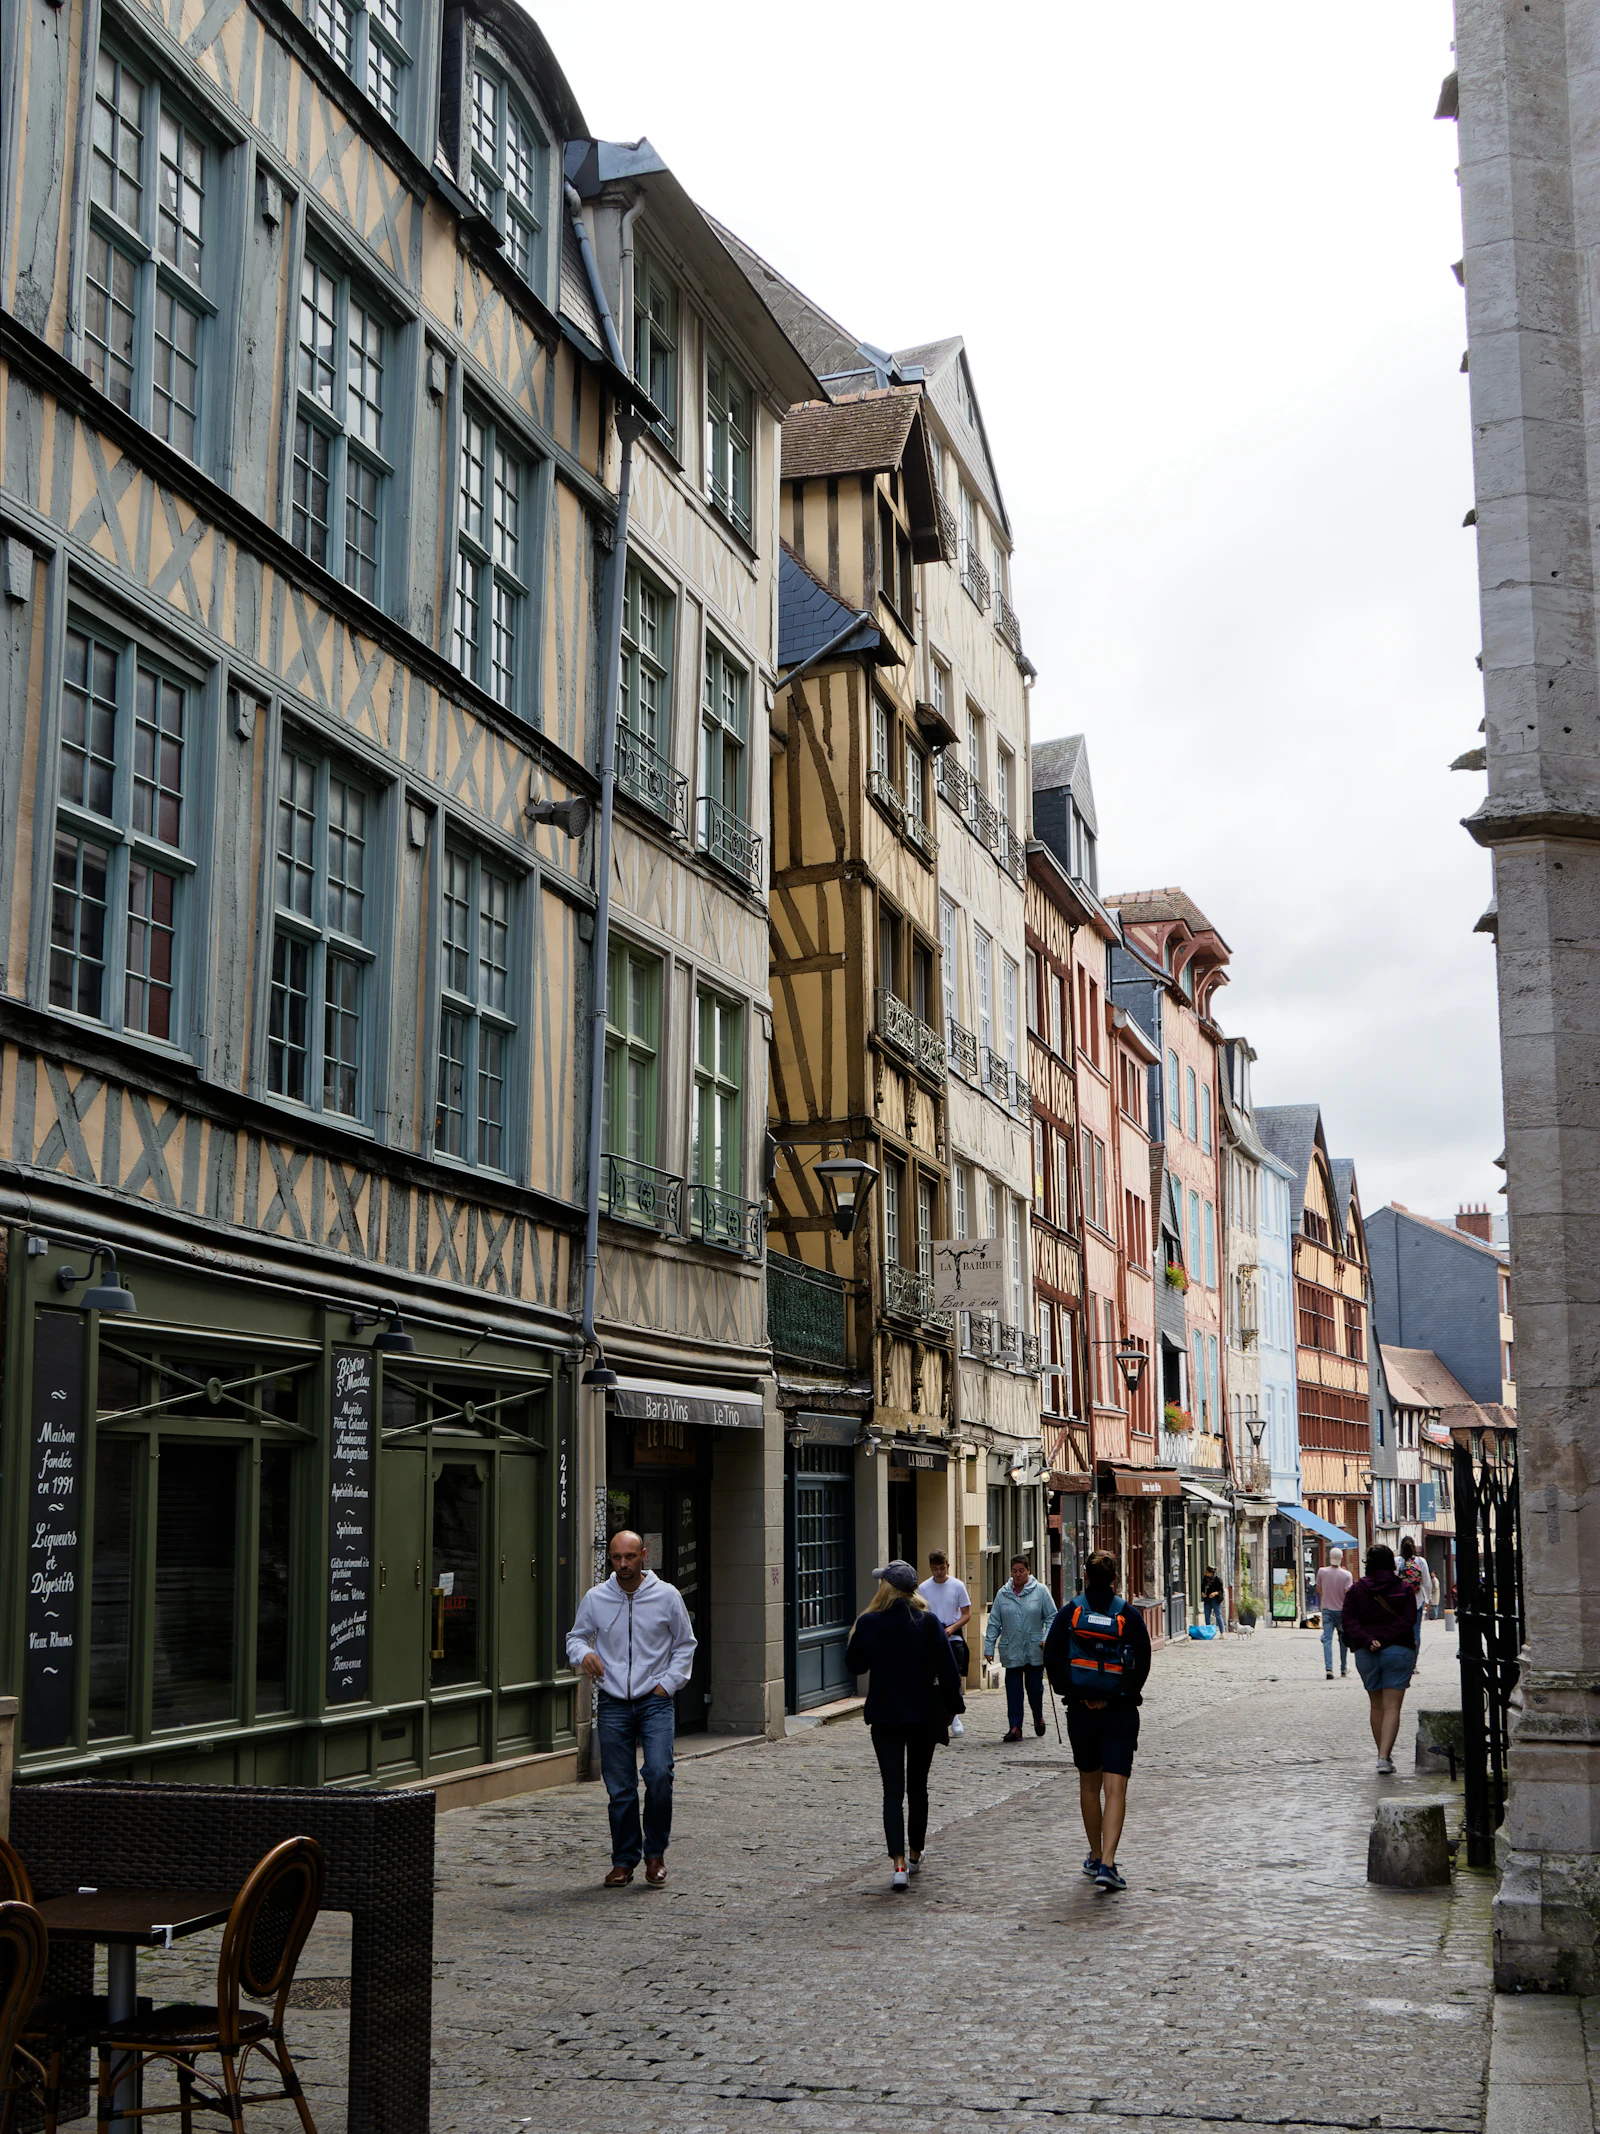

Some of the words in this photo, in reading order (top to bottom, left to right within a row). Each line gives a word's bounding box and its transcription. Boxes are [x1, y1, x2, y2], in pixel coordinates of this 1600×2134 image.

[940, 1263, 952, 1271] LA
[963, 1261, 1002, 1270] BARBUE
[940, 1294, 964, 1308] Bar
[978, 1297, 999, 1307] vin
[336, 1357, 365, 1381] Bistro
[344, 1372, 370, 1392] Maclou
[341, 1401, 362, 1418] Mojito
[645, 1396, 662, 1418] Bar
[663, 1398, 669, 1419] à
[670, 1399, 689, 1421] Vins
[713, 1404, 723, 1424] Le
[724, 1405, 740, 1425] Trio
[38, 1422, 75, 1443] Maison
[348, 1417, 368, 1430] Colada
[336, 1430, 367, 1445] Ambiance
[647, 1422, 658, 1449] LE
[663, 1421, 684, 1450] TRIO
[38, 1449, 73, 1479] fondée
[333, 1445, 369, 1464] Margarita
[908, 1453, 915, 1467] LA
[915, 1453, 934, 1468] BARBUE
[38, 1483, 49, 1494] en
[52, 1476, 74, 1495] 1991
[31, 1522, 77, 1556] Liqueurs
[46, 1555, 57, 1570] et
[31, 1572, 74, 1603] Digestifs
[29, 1632, 48, 1649] Vieux
[49, 1631, 73, 1648] Rhums
